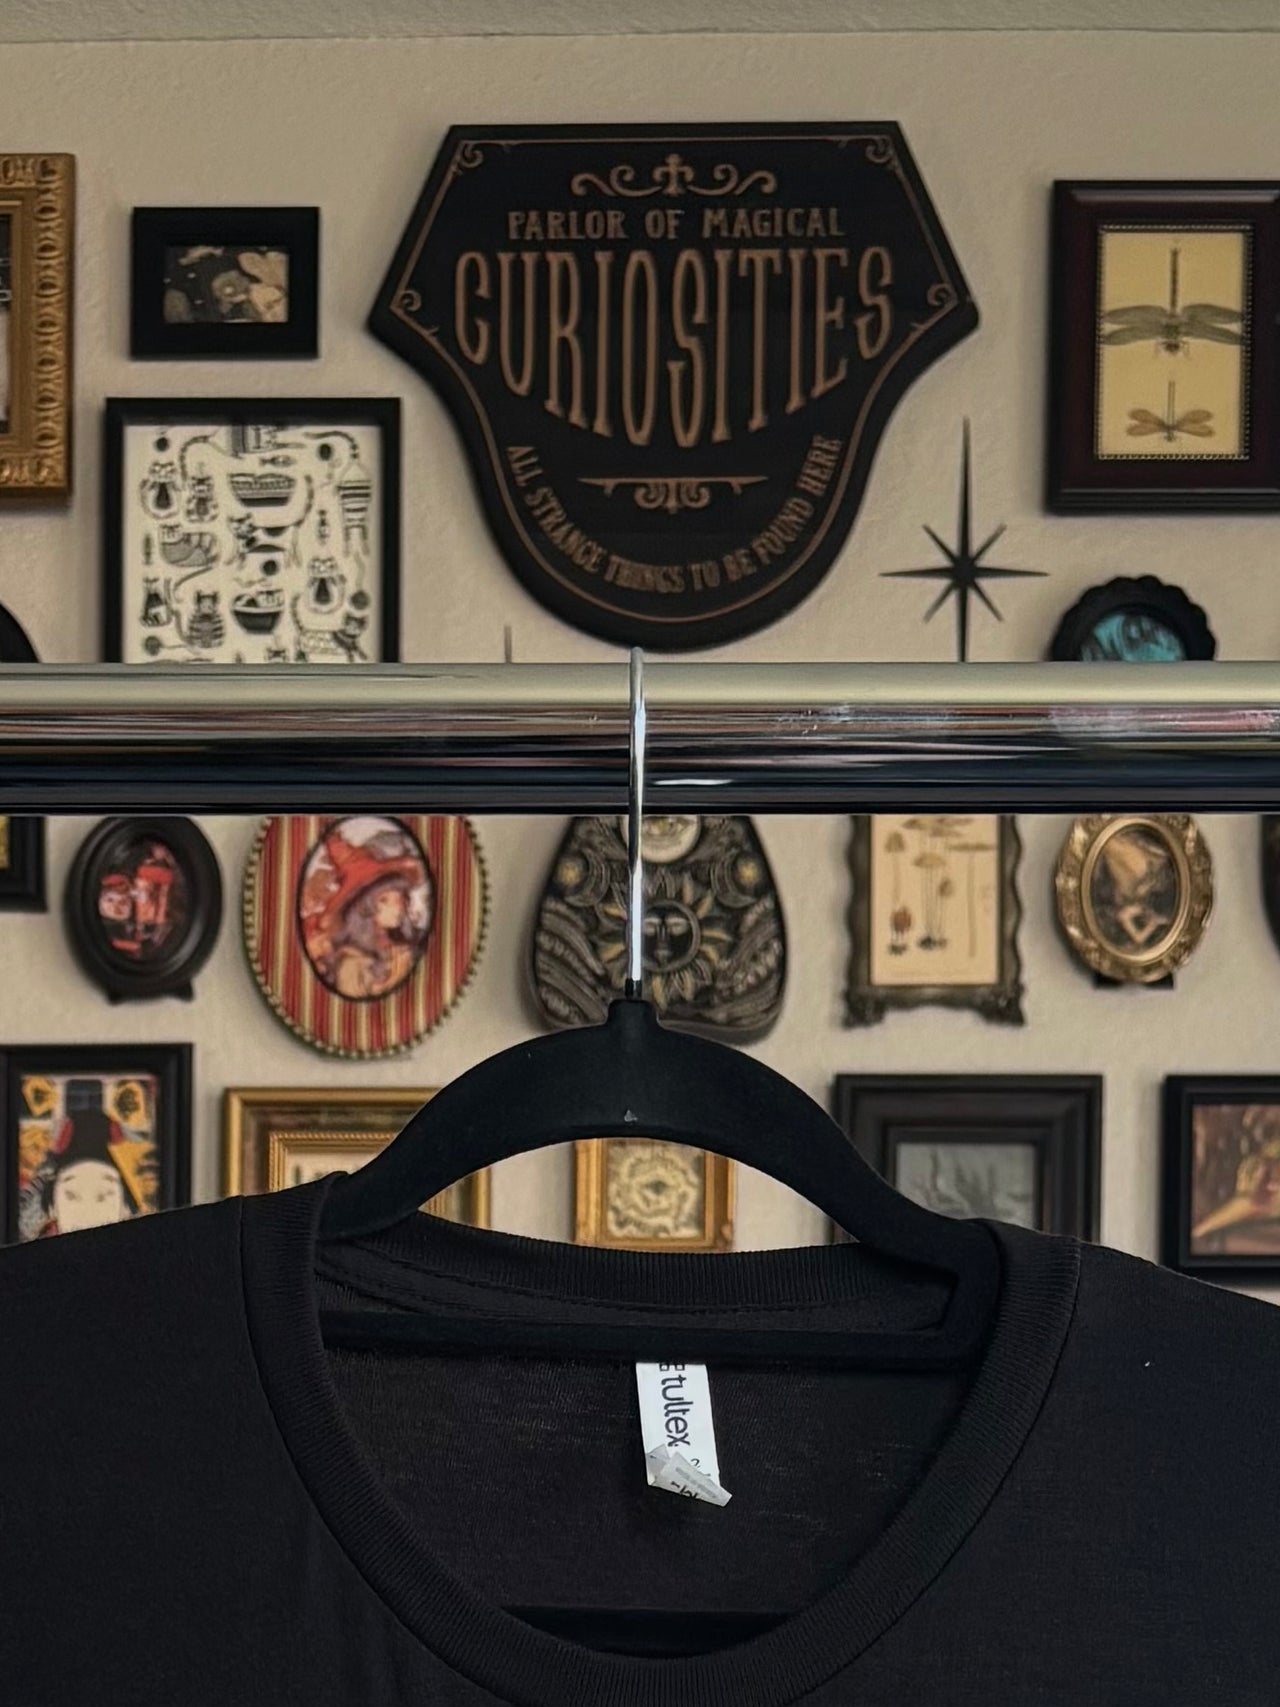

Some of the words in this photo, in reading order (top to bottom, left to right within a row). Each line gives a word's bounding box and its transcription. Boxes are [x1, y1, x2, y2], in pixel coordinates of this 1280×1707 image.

[508, 210, 628, 240] PARLOR
[645, 209, 685, 239] OF
[702, 207, 846, 239] MAGICAL
[454, 245, 894, 448] CURIOSITIES
[508, 446, 544, 487] ALL
[796, 434, 844, 497] HERE
[524, 486, 608, 574] STRANGE
[751, 496, 815, 565] FOUND
[604, 554, 685, 593] THINGS
[688, 560, 720, 591] TO
[722, 549, 757, 582] BE
[661, 1373, 691, 1448] tultex
